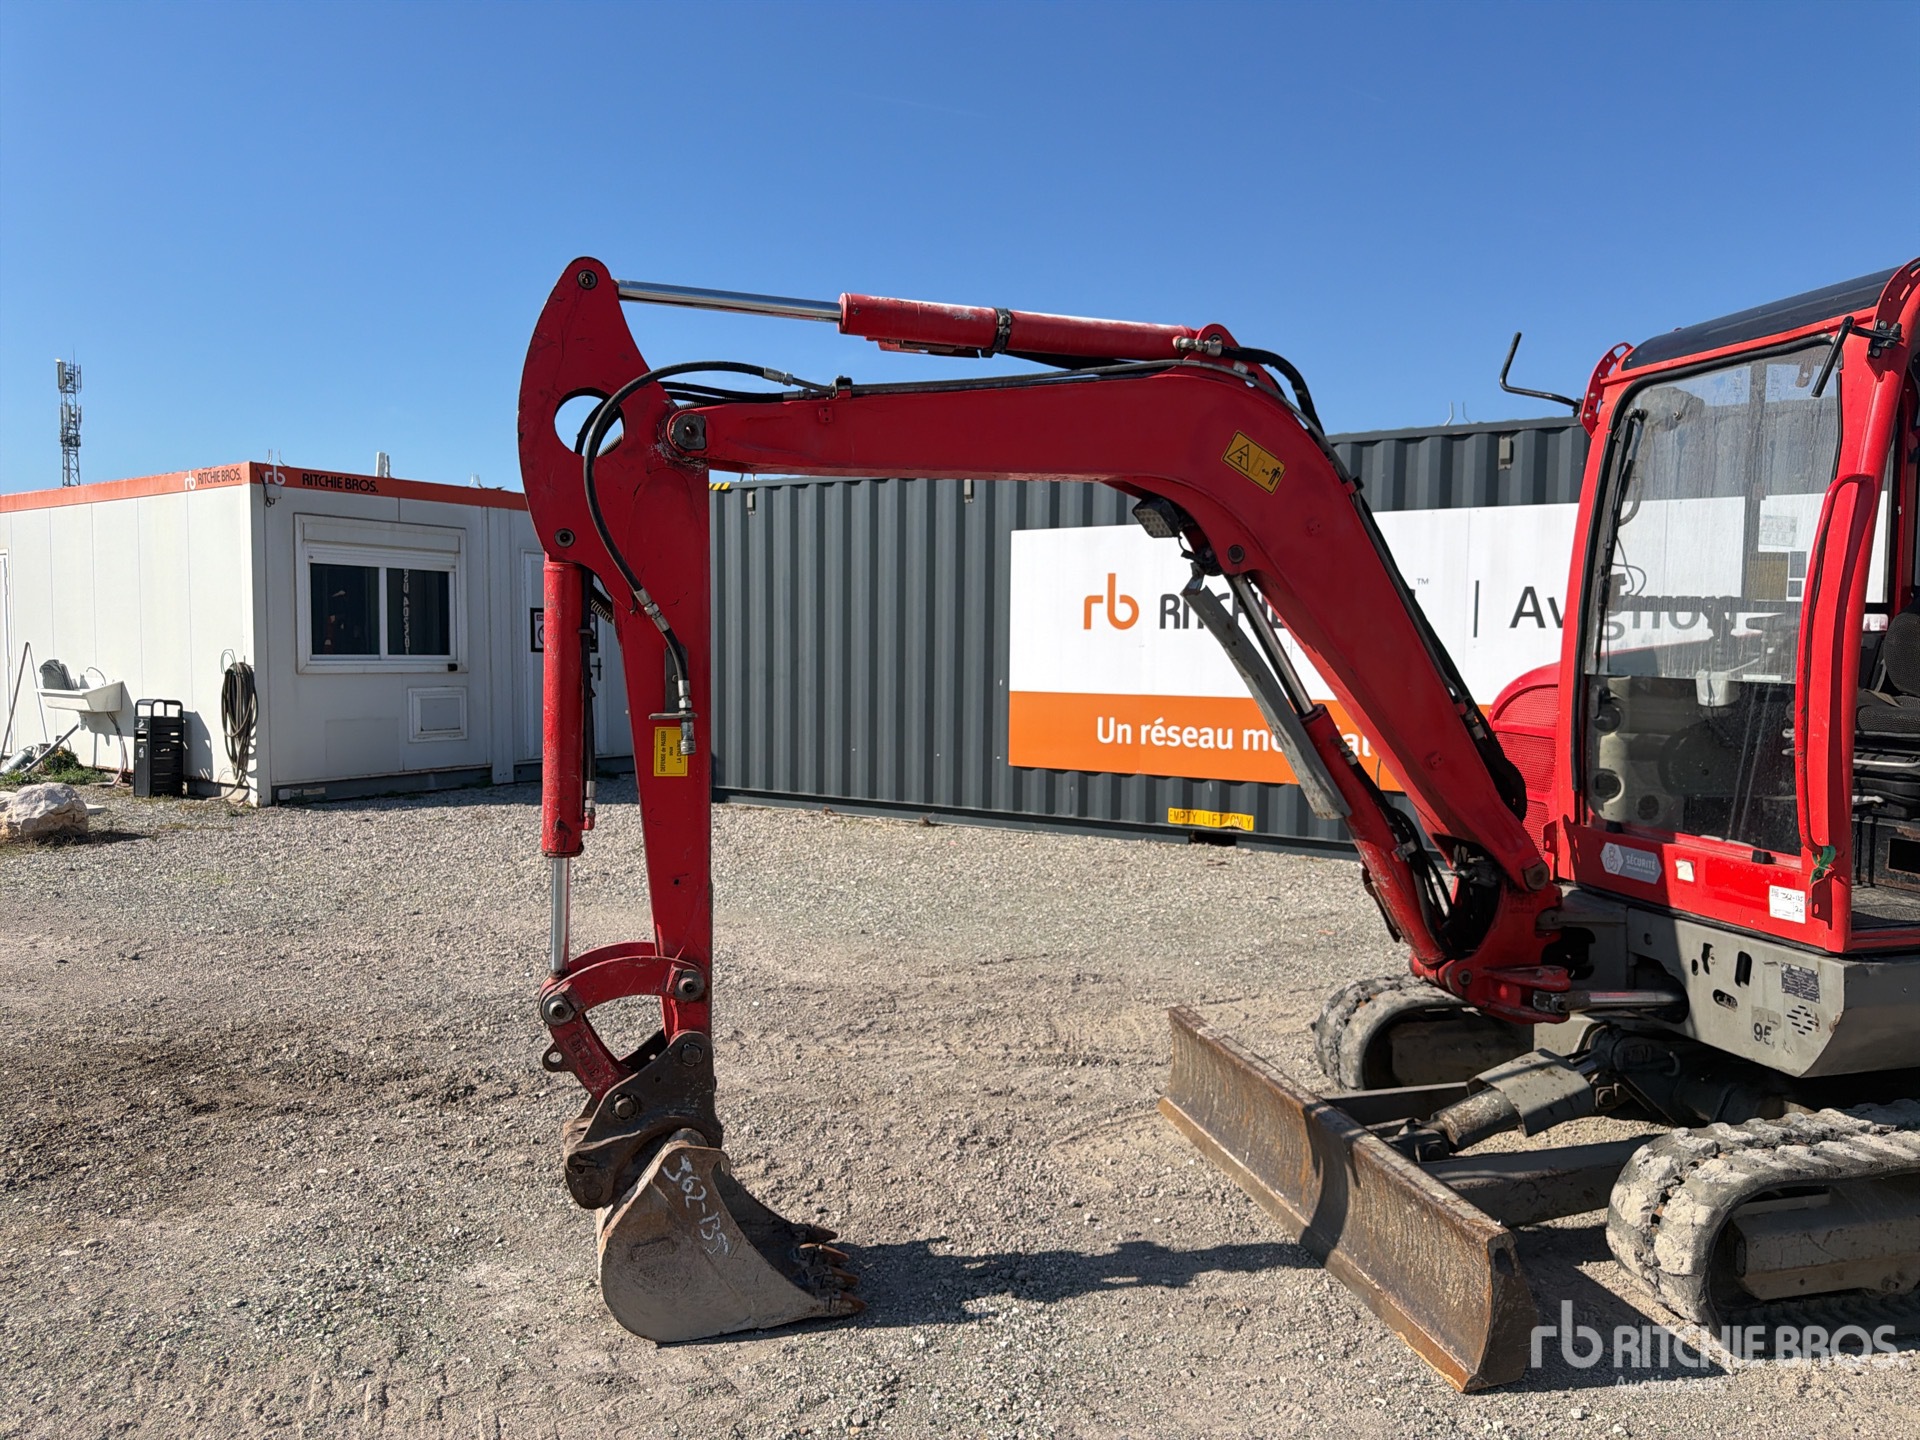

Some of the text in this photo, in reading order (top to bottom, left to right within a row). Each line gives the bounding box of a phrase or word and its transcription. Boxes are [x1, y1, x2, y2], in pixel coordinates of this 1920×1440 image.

[185, 470, 196, 490] rb
[197, 471, 221, 485] RITCHIE
[265, 466, 379, 493] rb RITCHIE BROS.
[1083, 573, 1140, 630] rb
[1097, 716, 1133, 745] Un
[1140, 716, 1234, 751] réseau
[1169, 809, 1198, 823] EMPTY
[1202, 812, 1224, 826] LIFT
[1626, 853, 1656, 870] SÉCURITÉ
